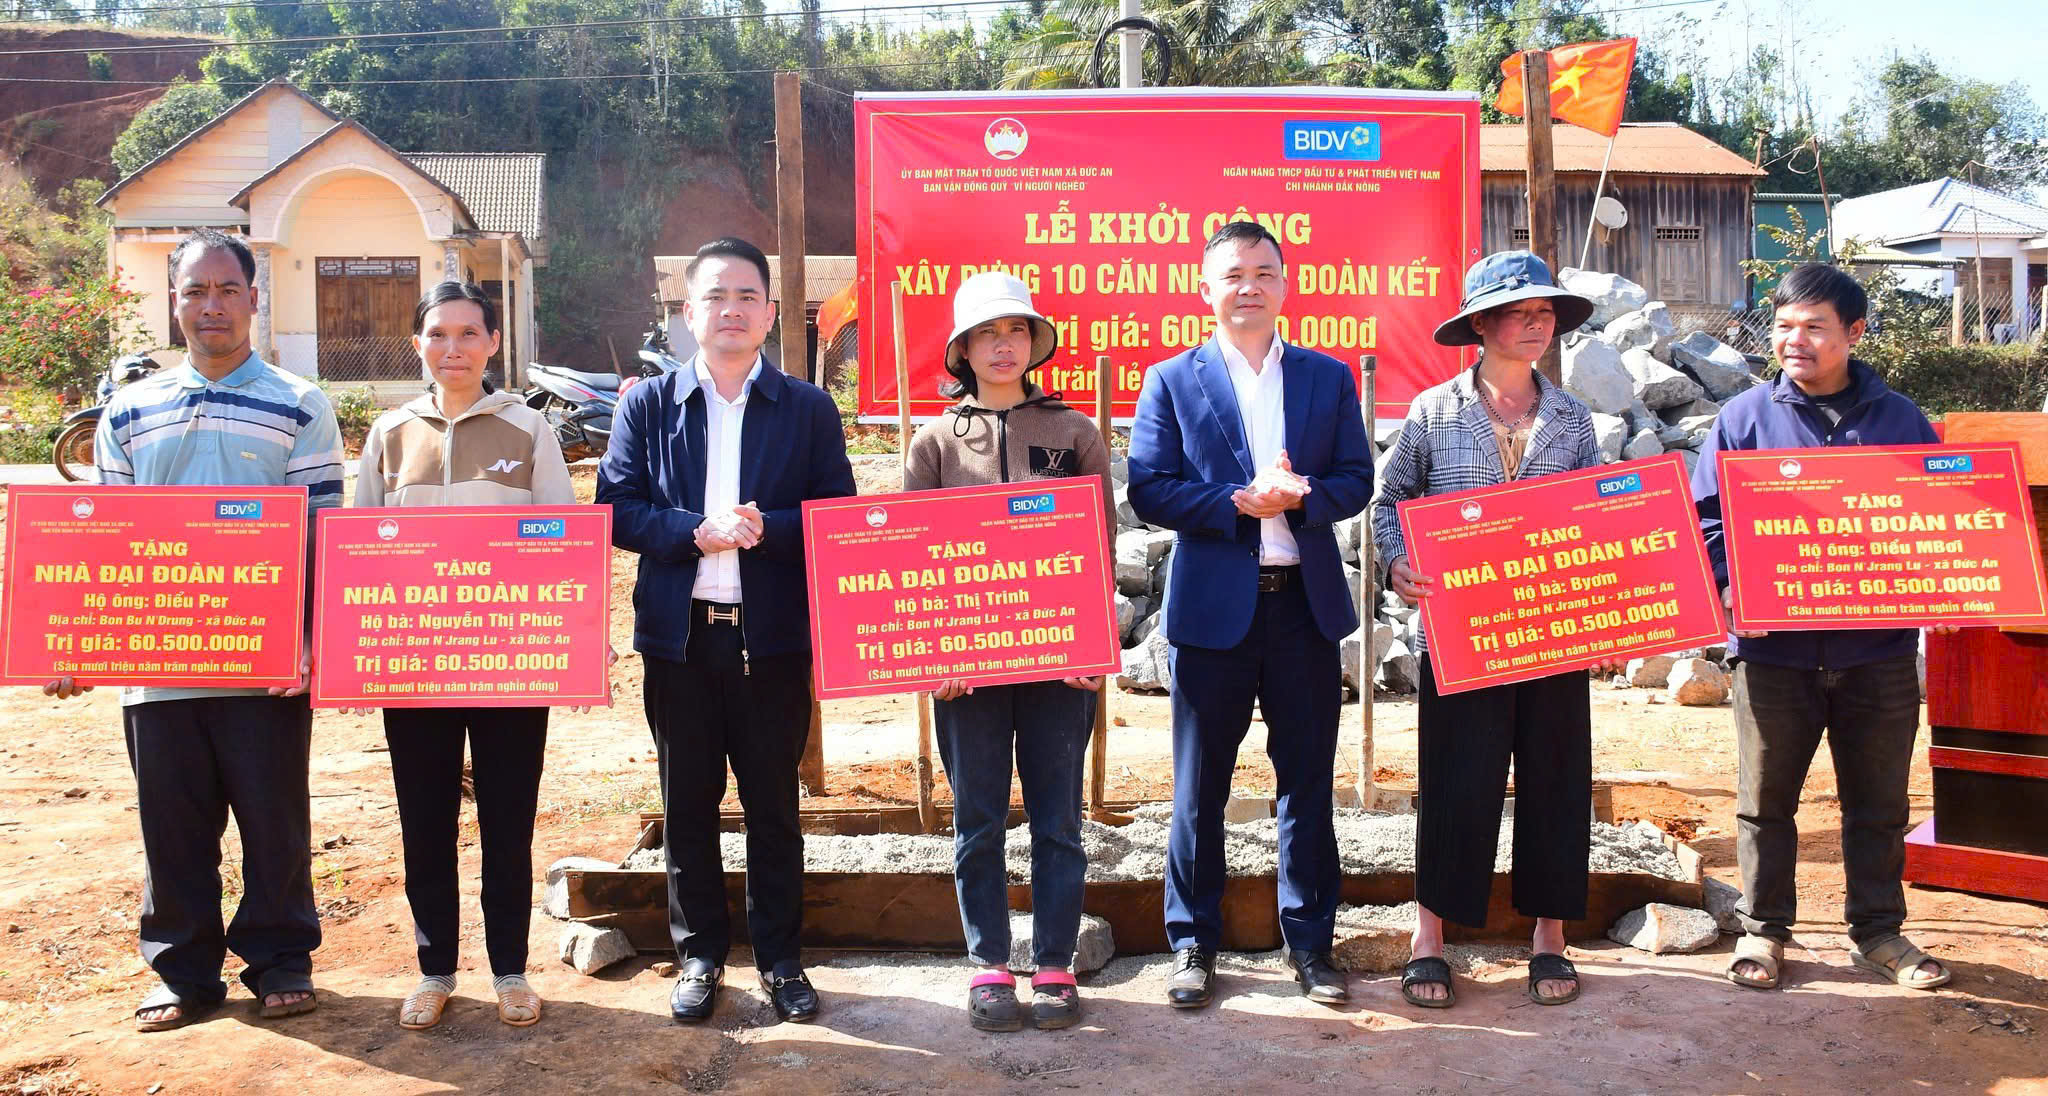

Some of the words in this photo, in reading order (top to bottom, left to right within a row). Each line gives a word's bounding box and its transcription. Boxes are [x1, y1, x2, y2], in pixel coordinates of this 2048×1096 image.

[1294, 130, 1350, 151] BIDV
[915, 169, 932, 178] BAN
[1042, 168, 1062, 177] NAM
[1100, 168, 1113, 177] AN
[1277, 168, 1302, 177] TMCP
[1337, 168, 1345, 177] &
[1420, 170, 1440, 180] NAM
[923, 183, 942, 192] BAN
[1285, 181, 1301, 191] CHI
[1025, 200, 1077, 244] LỄ
[1089, 202, 1191, 245] KHỞI
[896, 258, 951, 296] XÂY
[1052, 264, 1086, 294] 10
[1096, 257, 1158, 294] CĂN
[1298, 258, 1378, 296] ĐOÀN
[1387, 256, 1441, 297] KẾT
[1090, 312, 1150, 352] giá:
[1119, 362, 1141, 391] lẻ
[1927, 459, 1956, 470] BIDV
[1599, 481, 1627, 495] BIDV
[220, 504, 248, 516] BIDV
[1012, 499, 1040, 512] BIDV
[1842, 492, 1903, 512] TẶNG
[522, 523, 550, 534] BIDV
[1753, 515, 1810, 536] NHÀ
[1816, 516, 1863, 537] ĐẠI
[1869, 511, 1946, 532] ĐOÀN
[1953, 507, 2007, 530] KẾT
[1524, 524, 1581, 547] TẶNG
[129, 538, 188, 559] TẶNG
[927, 540, 986, 561] TẶNG
[1442, 561, 1498, 589] NHÀ
[1503, 554, 1547, 578] ĐẠI
[1553, 540, 1624, 569] ĐOÀN
[1630, 527, 1677, 555] KẾT
[1798, 543, 1821, 559] Hộ
[1826, 543, 1865, 557] ông:
[34, 561, 90, 582] NHÀ
[99, 565, 143, 587] ĐẠI
[151, 562, 224, 583] ĐOÀN
[233, 559, 283, 584] KẾT
[433, 559, 491, 579] TẶNG
[837, 568, 893, 594] NHÀ
[900, 567, 945, 590] ĐẠI
[953, 559, 1027, 584] ĐOÀN
[1034, 550, 1084, 576] KẾT
[343, 582, 396, 604] NHÀ
[404, 585, 447, 607] ĐẠI
[455, 580, 528, 603] ĐOÀN
[537, 578, 587, 602] KẾT
[1513, 584, 1536, 601] Hộ
[1539, 579, 1567, 596] bà:
[1772, 580, 1803, 599] Trị
[1810, 578, 1852, 597] giá:
[1858, 575, 2001, 595] 60.500.000đ
[83, 593, 106, 610] Hộ
[111, 593, 149, 609] ông:
[199, 593, 228, 608] Per
[894, 597, 917, 615] Hộ
[922, 595, 949, 611] bà:
[953, 592, 980, 610] Thị
[985, 588, 1029, 605] Trinh
[48, 614, 69, 624] Địa
[72, 615, 96, 625] chỉ:
[99, 615, 122, 625] Bon
[126, 615, 142, 625] Bu
[205, 617, 220, 625] xã
[223, 615, 246, 625] Đức
[249, 615, 265, 626] An
[360, 614, 382, 632] Hộ
[387, 613, 413, 628] bà:
[419, 610, 483, 629] Nguyễn
[487, 612, 513, 630] Thị
[519, 611, 563, 627] Phúc
[856, 623, 877, 636] Địa
[880, 620, 903, 632] chỉ:
[907, 619, 930, 630] Bon
[984, 613, 999, 623] Lu
[1015, 611, 1029, 620] xã
[1032, 607, 1056, 619] Đức
[1059, 605, 1075, 616] An
[1469, 631, 1499, 652] Trị
[1504, 624, 1544, 648] giá:
[1549, 598, 1679, 637] 60.500.000đ
[44, 633, 72, 654] Trị
[81, 632, 121, 652] giá:
[128, 634, 262, 651] 60.500.000đ
[358, 636, 378, 646] Địa
[381, 633, 403, 646] chỉ:
[406, 635, 429, 645] Bon
[483, 634, 497, 644] Lu
[509, 635, 524, 644] xã
[527, 633, 551, 644] Đức
[553, 633, 570, 644] An
[855, 641, 884, 662] Trị
[891, 637, 933, 658] giá:
[939, 624, 1075, 652] 60.500.000đ
[353, 655, 380, 675] Trị
[388, 653, 427, 674] giá:
[434, 652, 568, 671] 60.500.000đ
